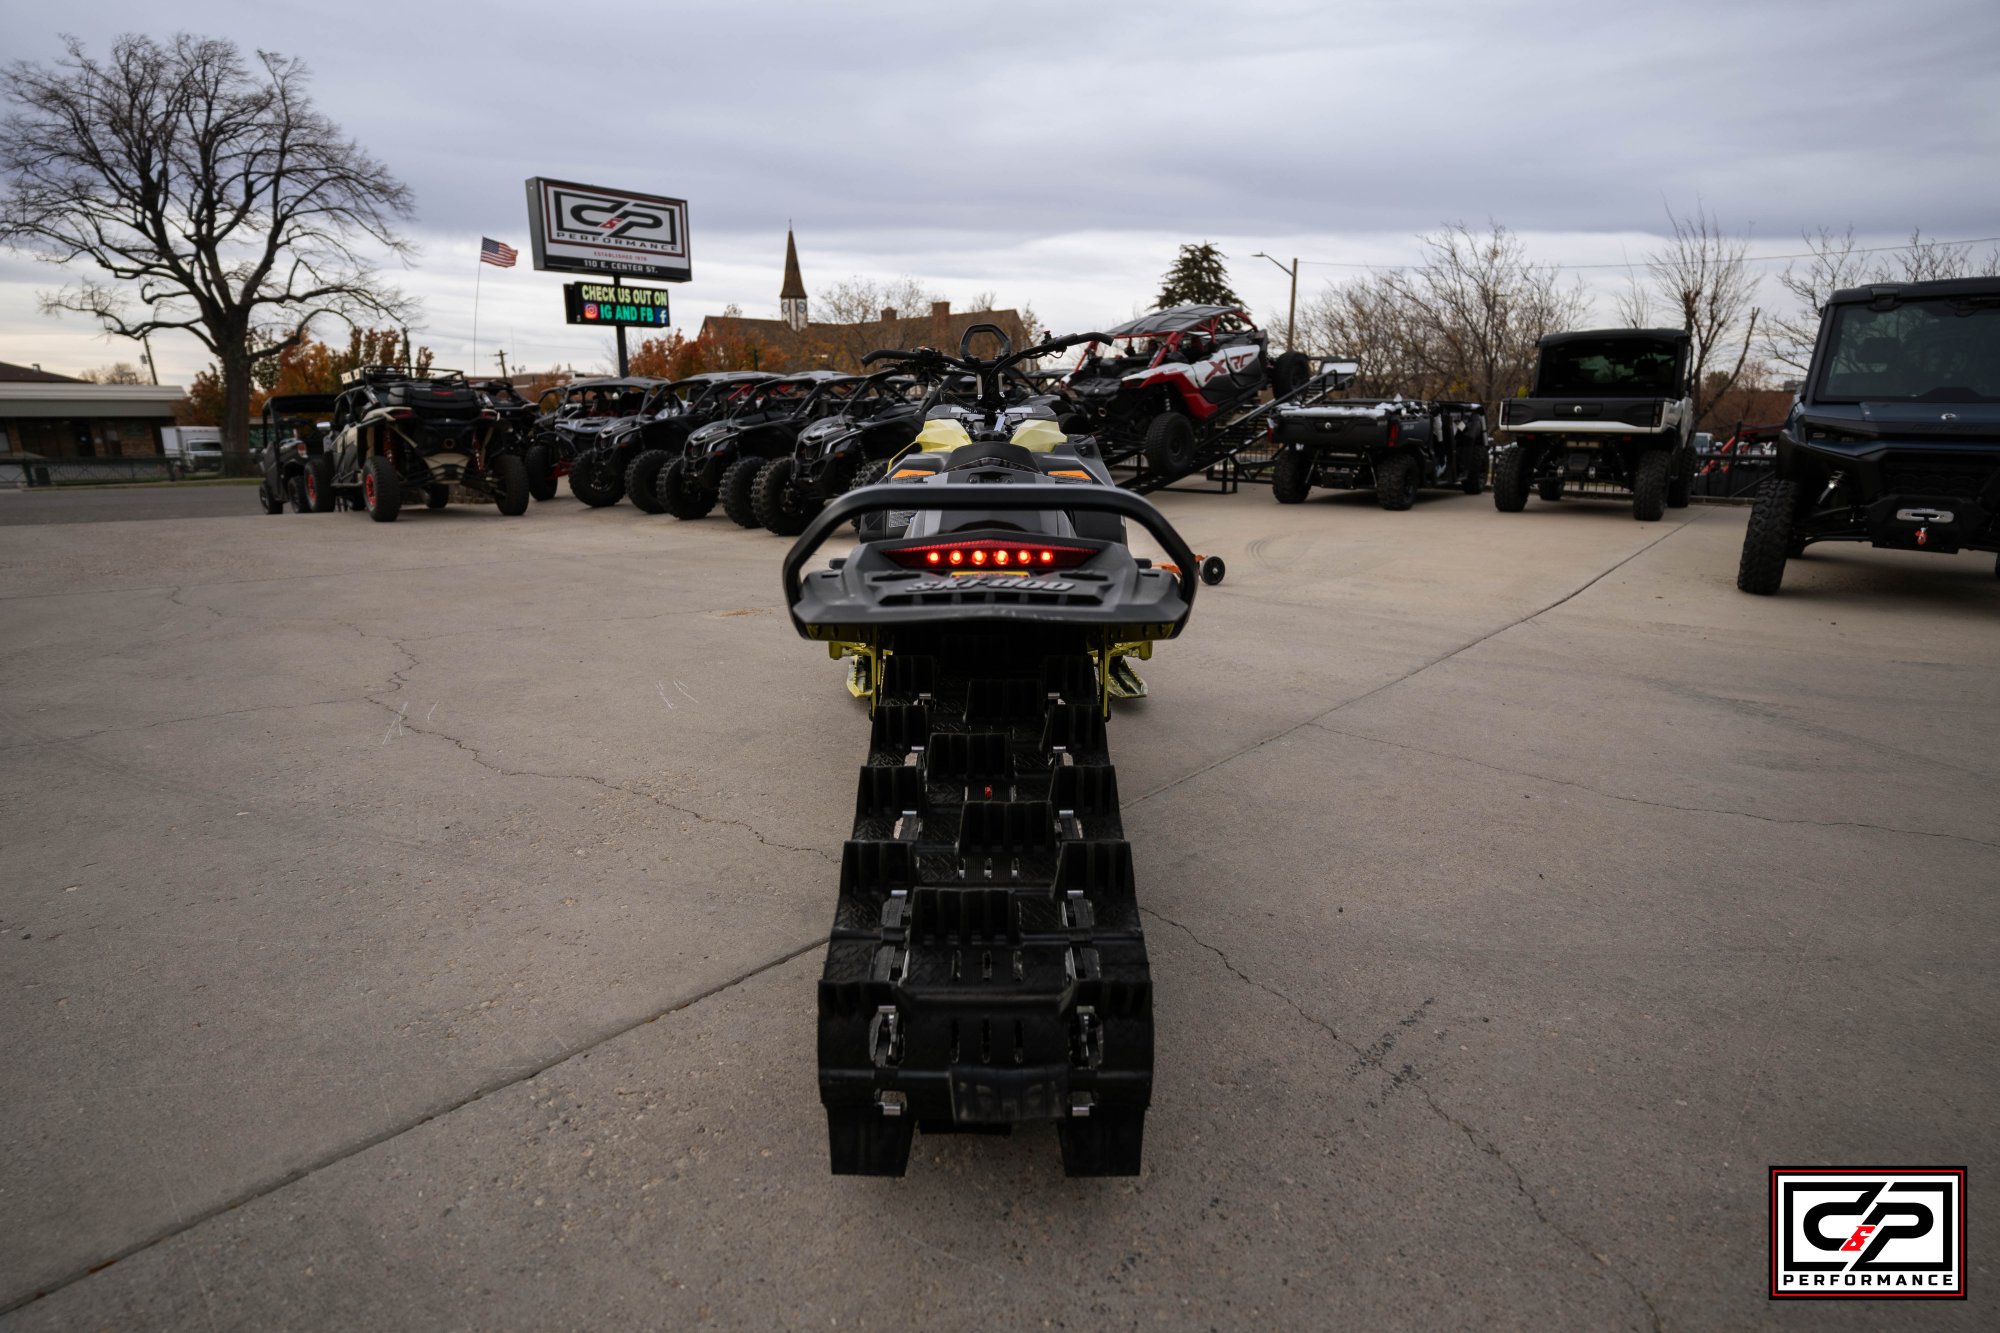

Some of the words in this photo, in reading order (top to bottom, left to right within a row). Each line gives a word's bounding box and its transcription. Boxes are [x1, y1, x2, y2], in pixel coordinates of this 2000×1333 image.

[556, 231, 678, 251] PERFORMANCE
[593, 251, 633, 261] ESTABLISHED
[584, 260, 598, 268] 110
[600, 261, 609, 269] E.
[611, 262, 643, 272] CENTER
[581, 285, 616, 302] CHECK
[617, 288, 631, 303] US
[632, 290, 652, 305] OUT
[654, 291, 667, 306] ON
[600, 304, 612, 320] IG
[615, 305, 637, 321] AND
[640, 307, 654, 323] FB
